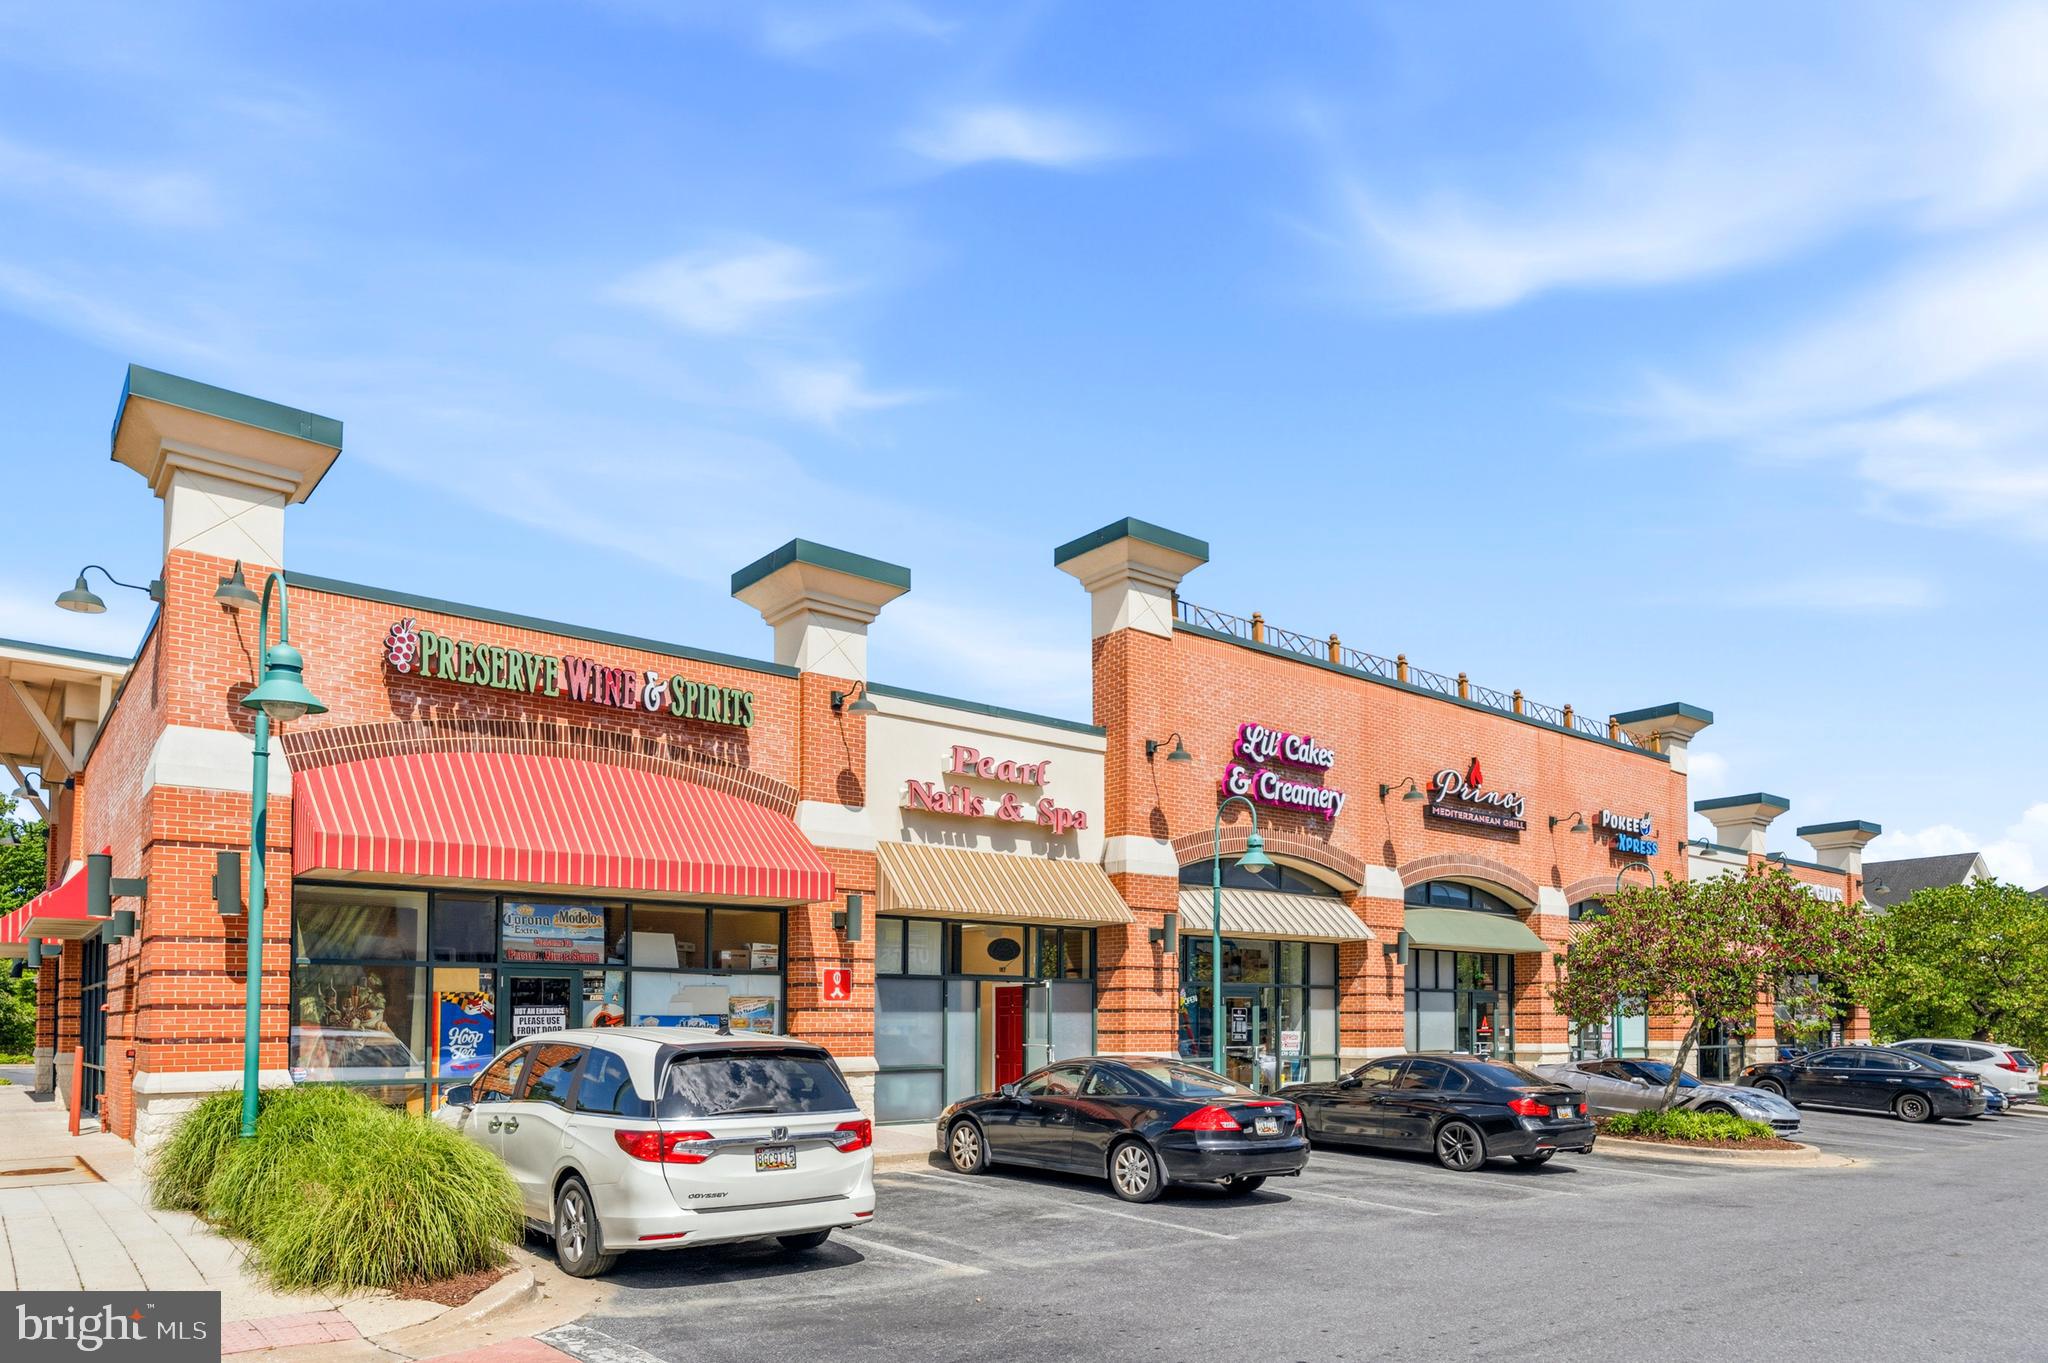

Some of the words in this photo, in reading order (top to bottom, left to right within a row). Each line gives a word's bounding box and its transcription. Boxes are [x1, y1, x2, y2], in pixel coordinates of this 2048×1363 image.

[418, 630, 560, 697] PRESERVE
[564, 655, 637, 709] WINE
[643, 671, 667, 712] &
[671, 674, 755, 728] SPIRITS
[1242, 726, 1282, 762] Lil'
[1285, 735, 1336, 768] Cakes
[951, 745, 1052, 786] Pearl
[1229, 766, 1252, 795] &
[1260, 772, 1346, 817] Creamery
[1436, 769, 1526, 818] Prino's
[905, 779, 985, 818] Nails
[998, 792, 1025, 822] &
[1038, 797, 1088, 835] Spa
[1432, 806, 1501, 826] MEDITERRANEAN
[1502, 819, 1526, 830] GRILL
[1602, 809, 1640, 833] POKEE
[1618, 833, 1659, 856] XPRESS
[503, 912, 550, 926] Corona
[559, 910, 597, 925] Modelo
[514, 925, 539, 935] Extra
[517, 1026, 540, 1035] FRONT
[519, 1016, 545, 1025] PLEASE
[547, 1016, 560, 1025] USE
[448, 1027, 484, 1048] Hoop
[449, 1045, 477, 1060] Tea
[688, 1191, 728, 1200] ODYSSEY
